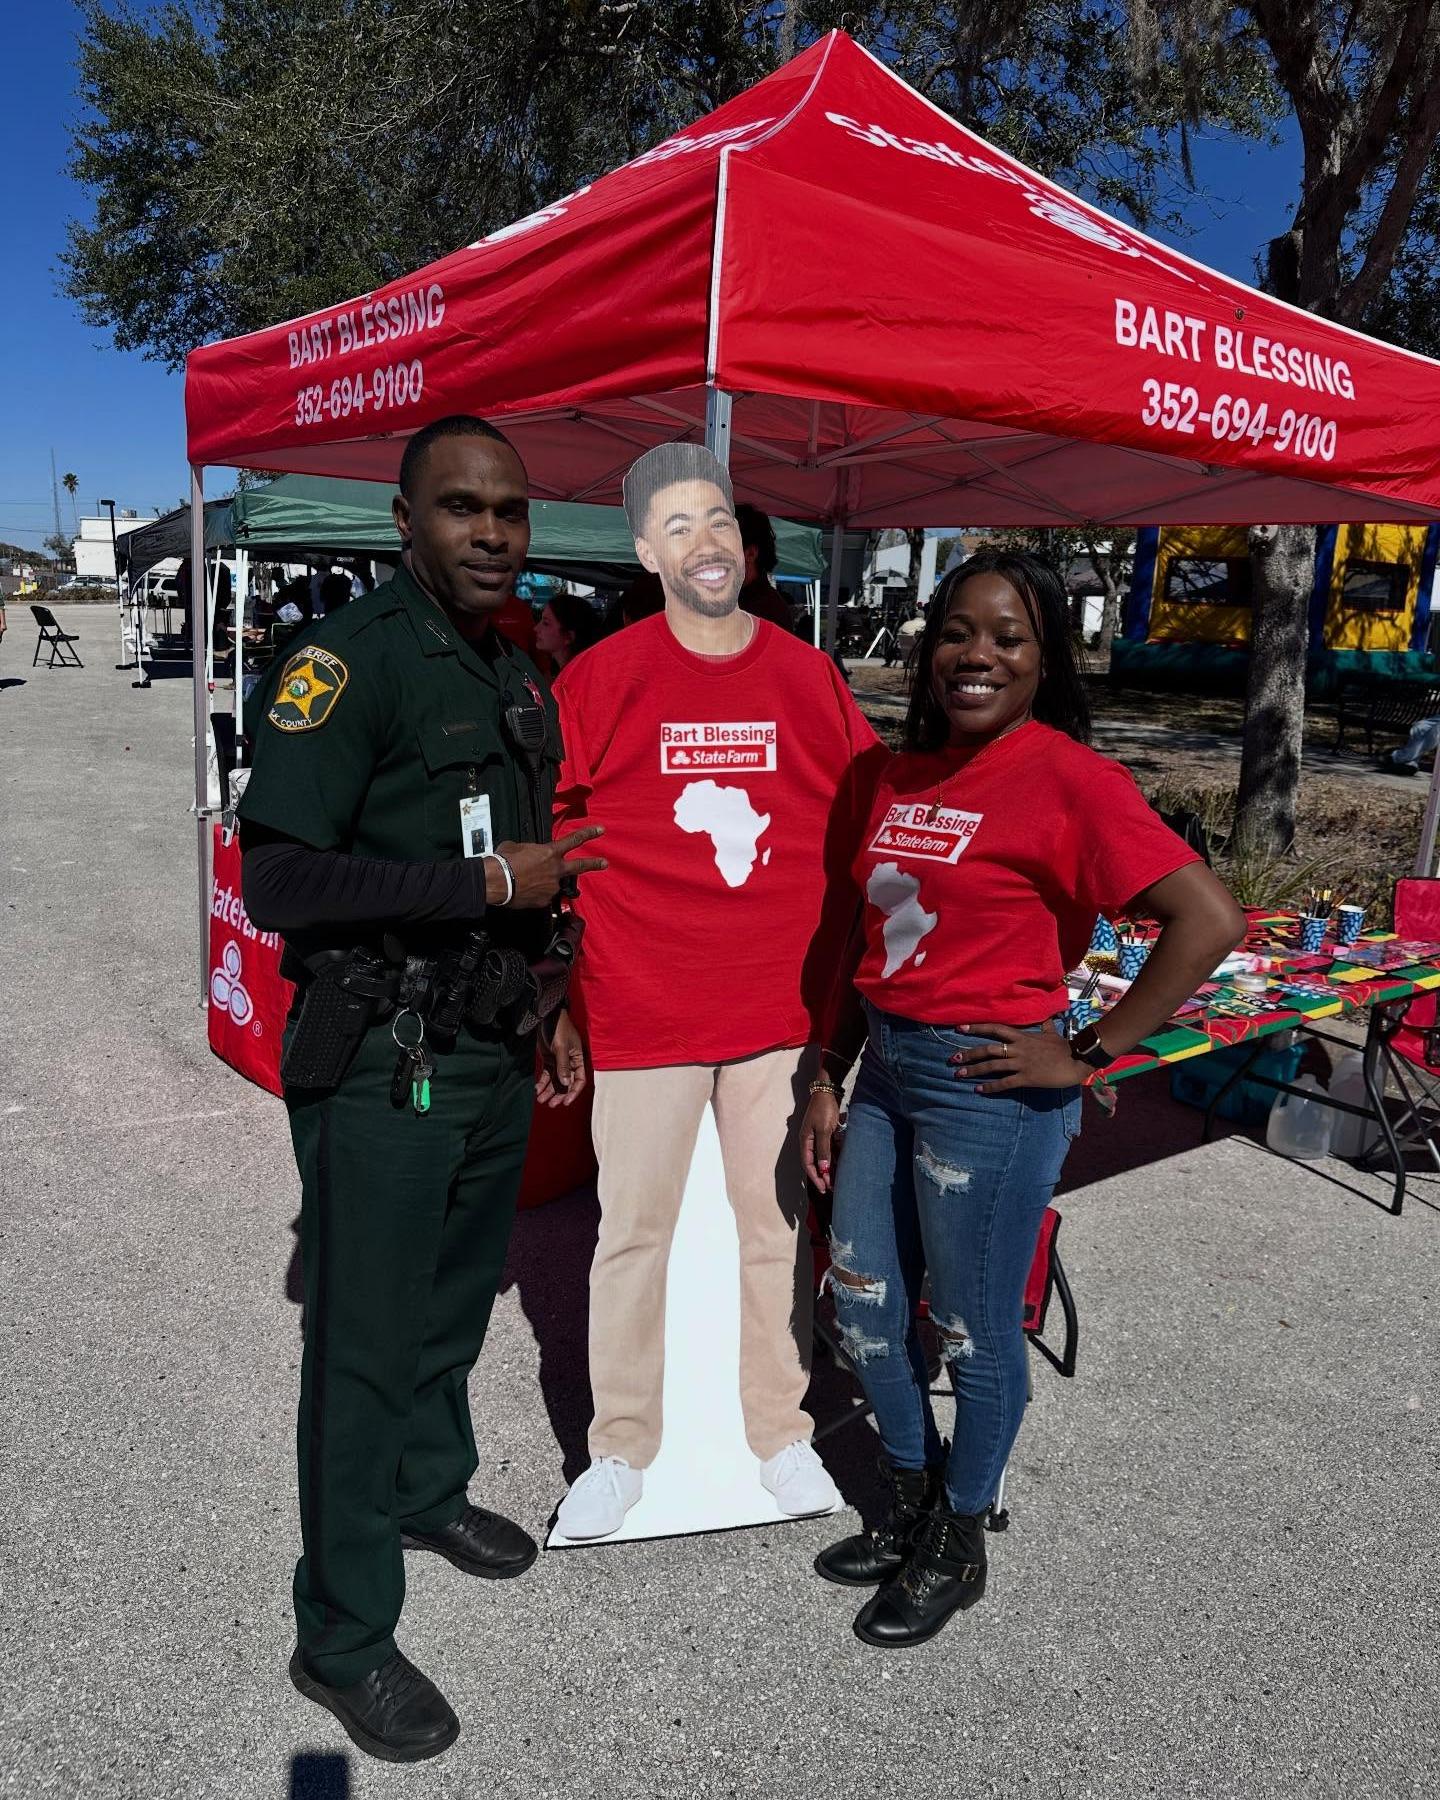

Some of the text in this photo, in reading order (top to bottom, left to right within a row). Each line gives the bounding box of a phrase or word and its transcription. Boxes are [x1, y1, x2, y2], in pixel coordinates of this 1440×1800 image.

[288, 283, 446, 370] BART BLESSING
[1115, 298, 1356, 400] BART BLESSING
[295, 358, 424, 426] 352-694-9100
[1141, 378, 1337, 462] 352-694-9100
[280, 718, 313, 728] COUNTY
[661, 726, 776, 744] Bart Blessing
[692, 749, 759, 765] StateFarm
[892, 831, 949, 852] StateFarm
